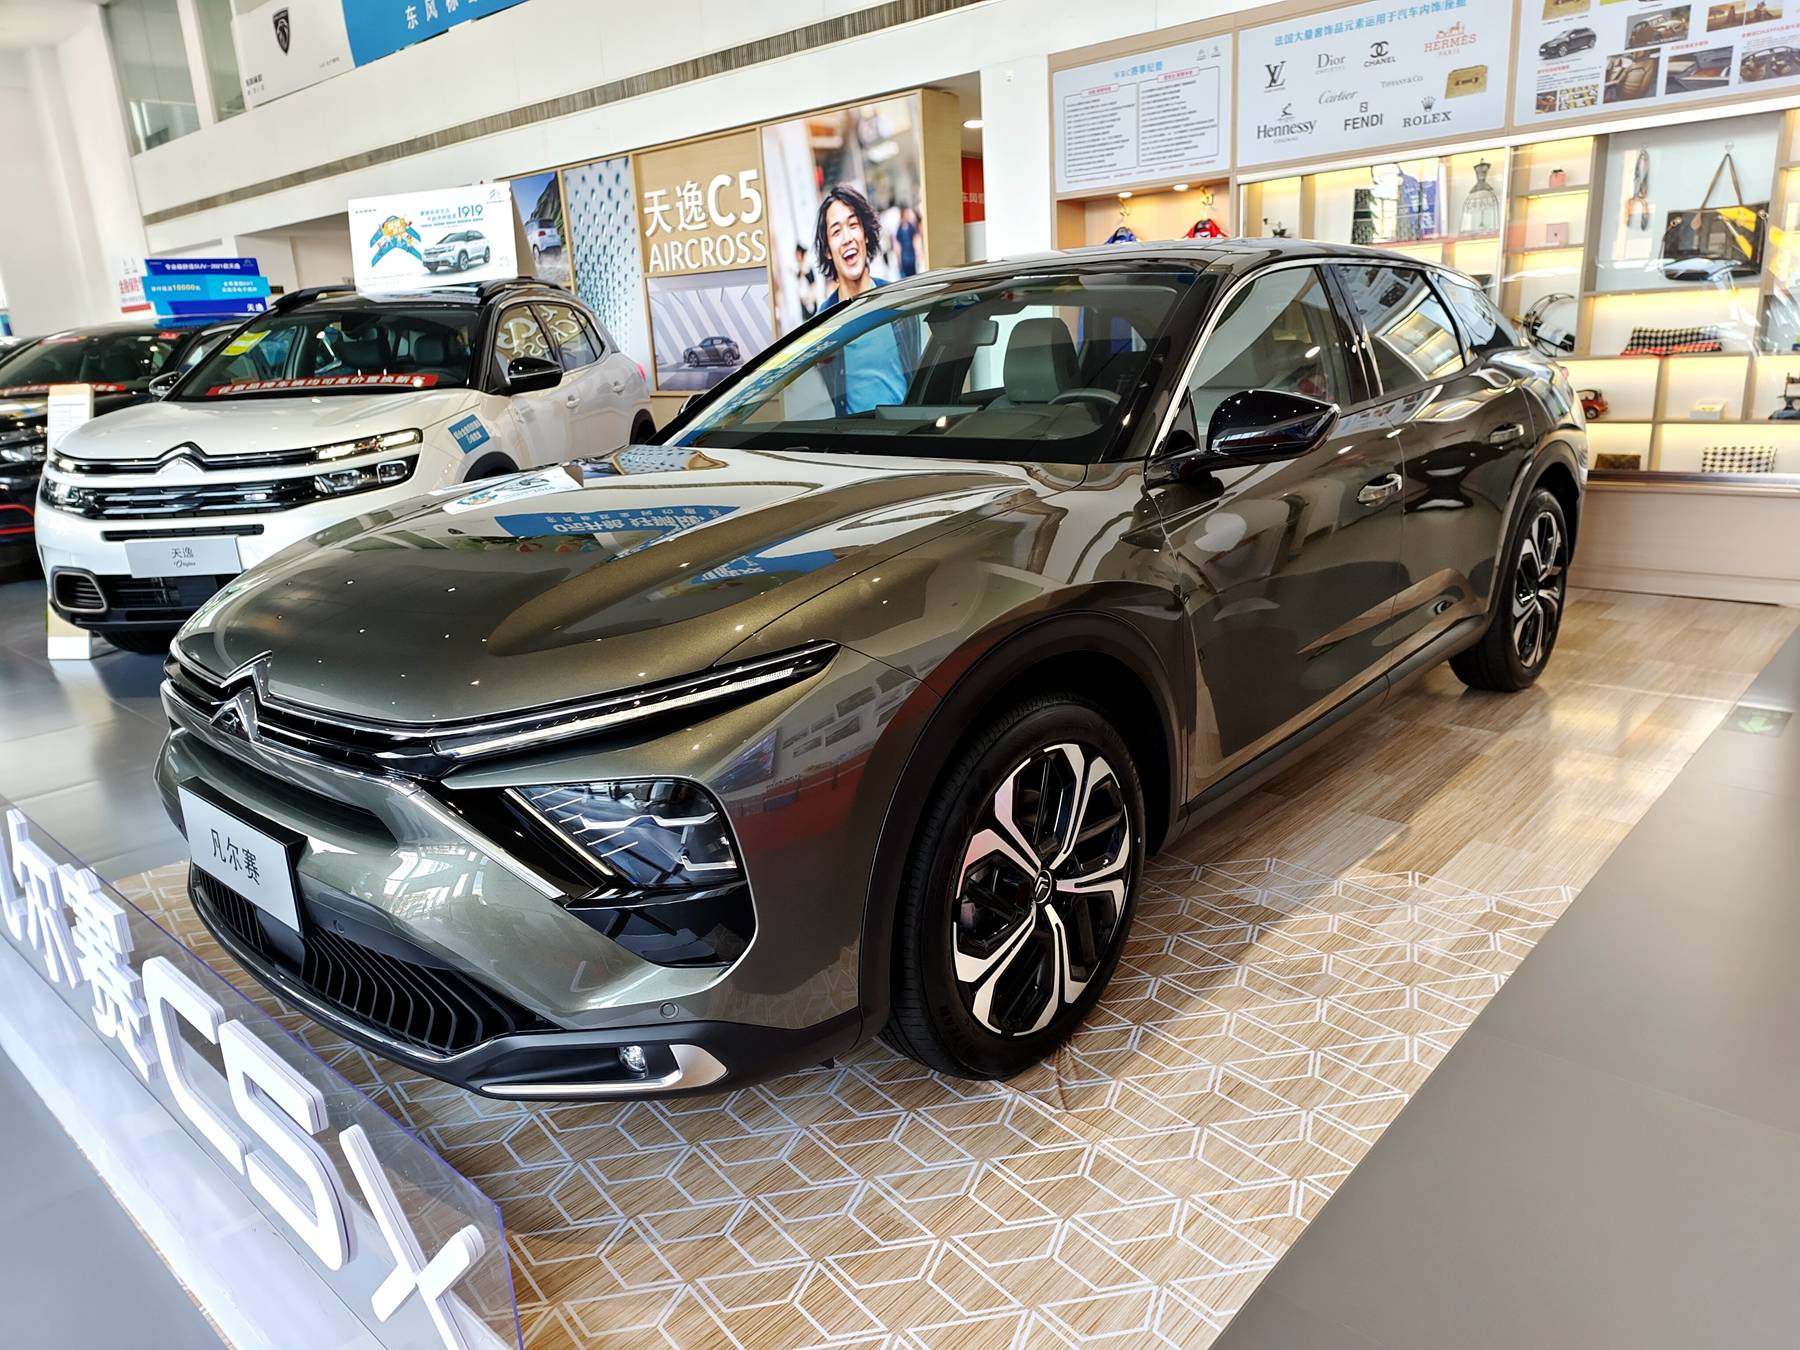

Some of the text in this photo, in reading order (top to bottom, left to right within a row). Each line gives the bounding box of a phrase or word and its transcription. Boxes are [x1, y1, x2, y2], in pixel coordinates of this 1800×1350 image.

[1317, 53, 1347, 69] Dior
[1364, 55, 1397, 68] CHANEL
[1318, 88, 1358, 106] Cartier
[1343, 112, 1384, 132] FENDI
[1402, 111, 1452, 128] ROLEX
[1256, 119, 1317, 141] Hennessy
[457, 204, 484, 219] 1919
[648, 228, 767, 273] AIRCROSS
[171, 546, 195, 559] 天逸
[210, 827, 262, 887] 凡尔赛
